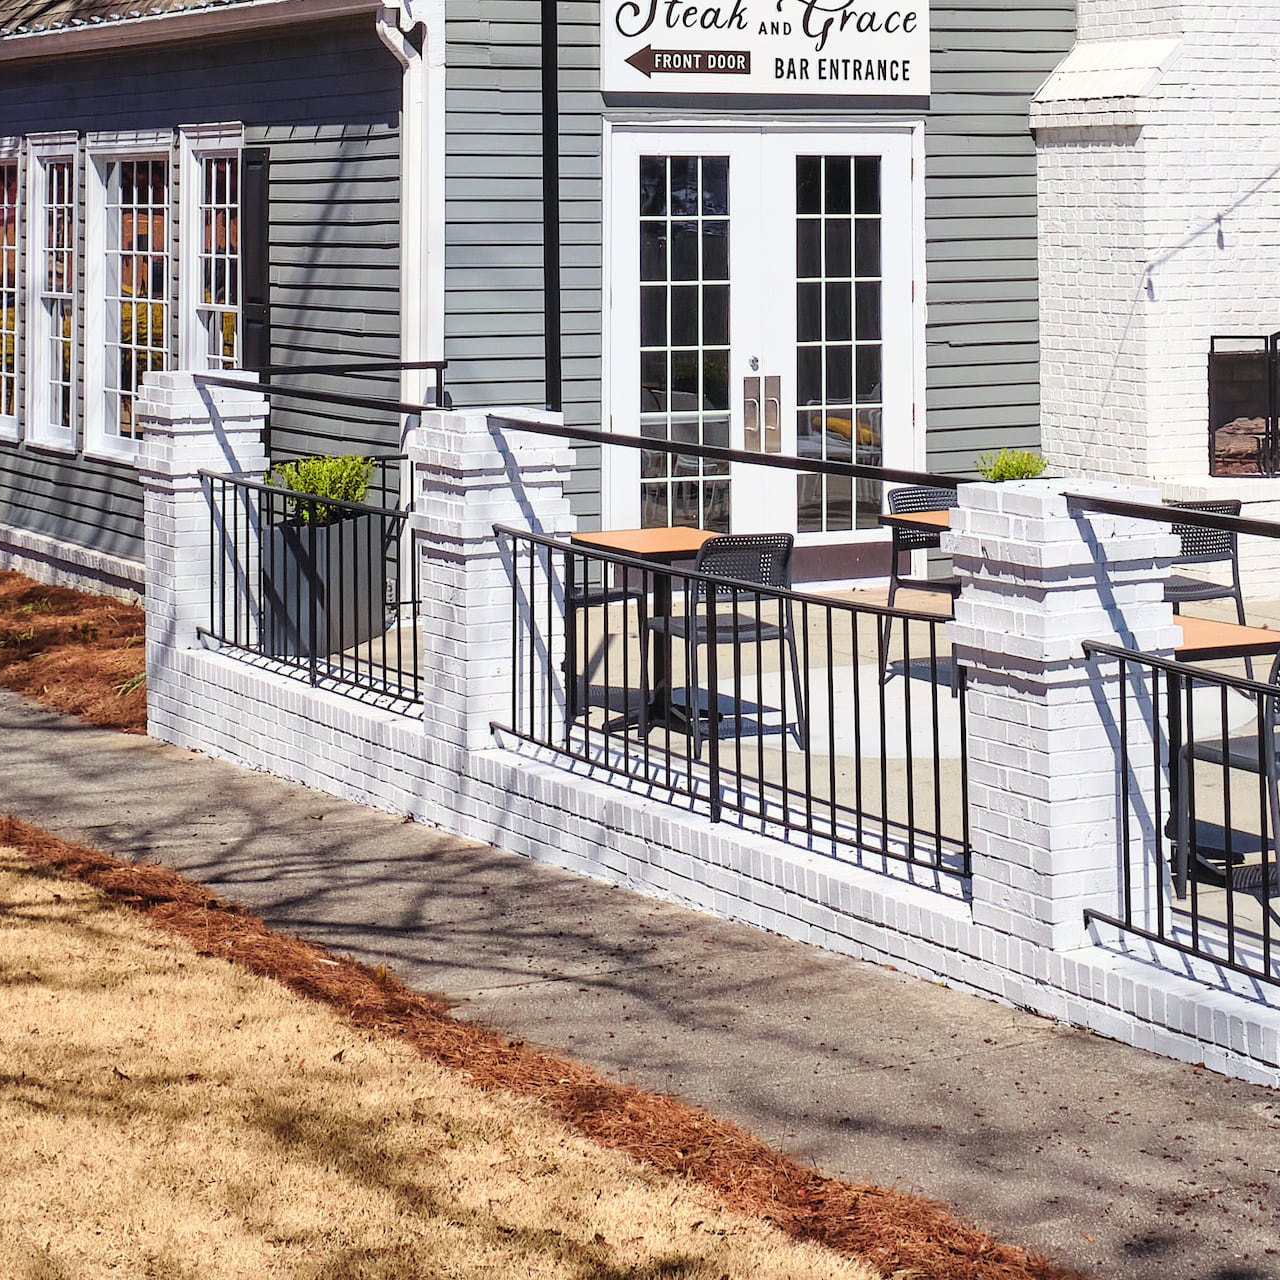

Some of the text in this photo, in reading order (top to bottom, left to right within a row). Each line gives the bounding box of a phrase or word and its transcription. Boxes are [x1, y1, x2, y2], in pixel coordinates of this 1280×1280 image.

[758, 21, 792, 35] AND
[654, 53, 746, 70] FRONT DOOR
[775, 57, 910, 81] BAR ENTRANCE
